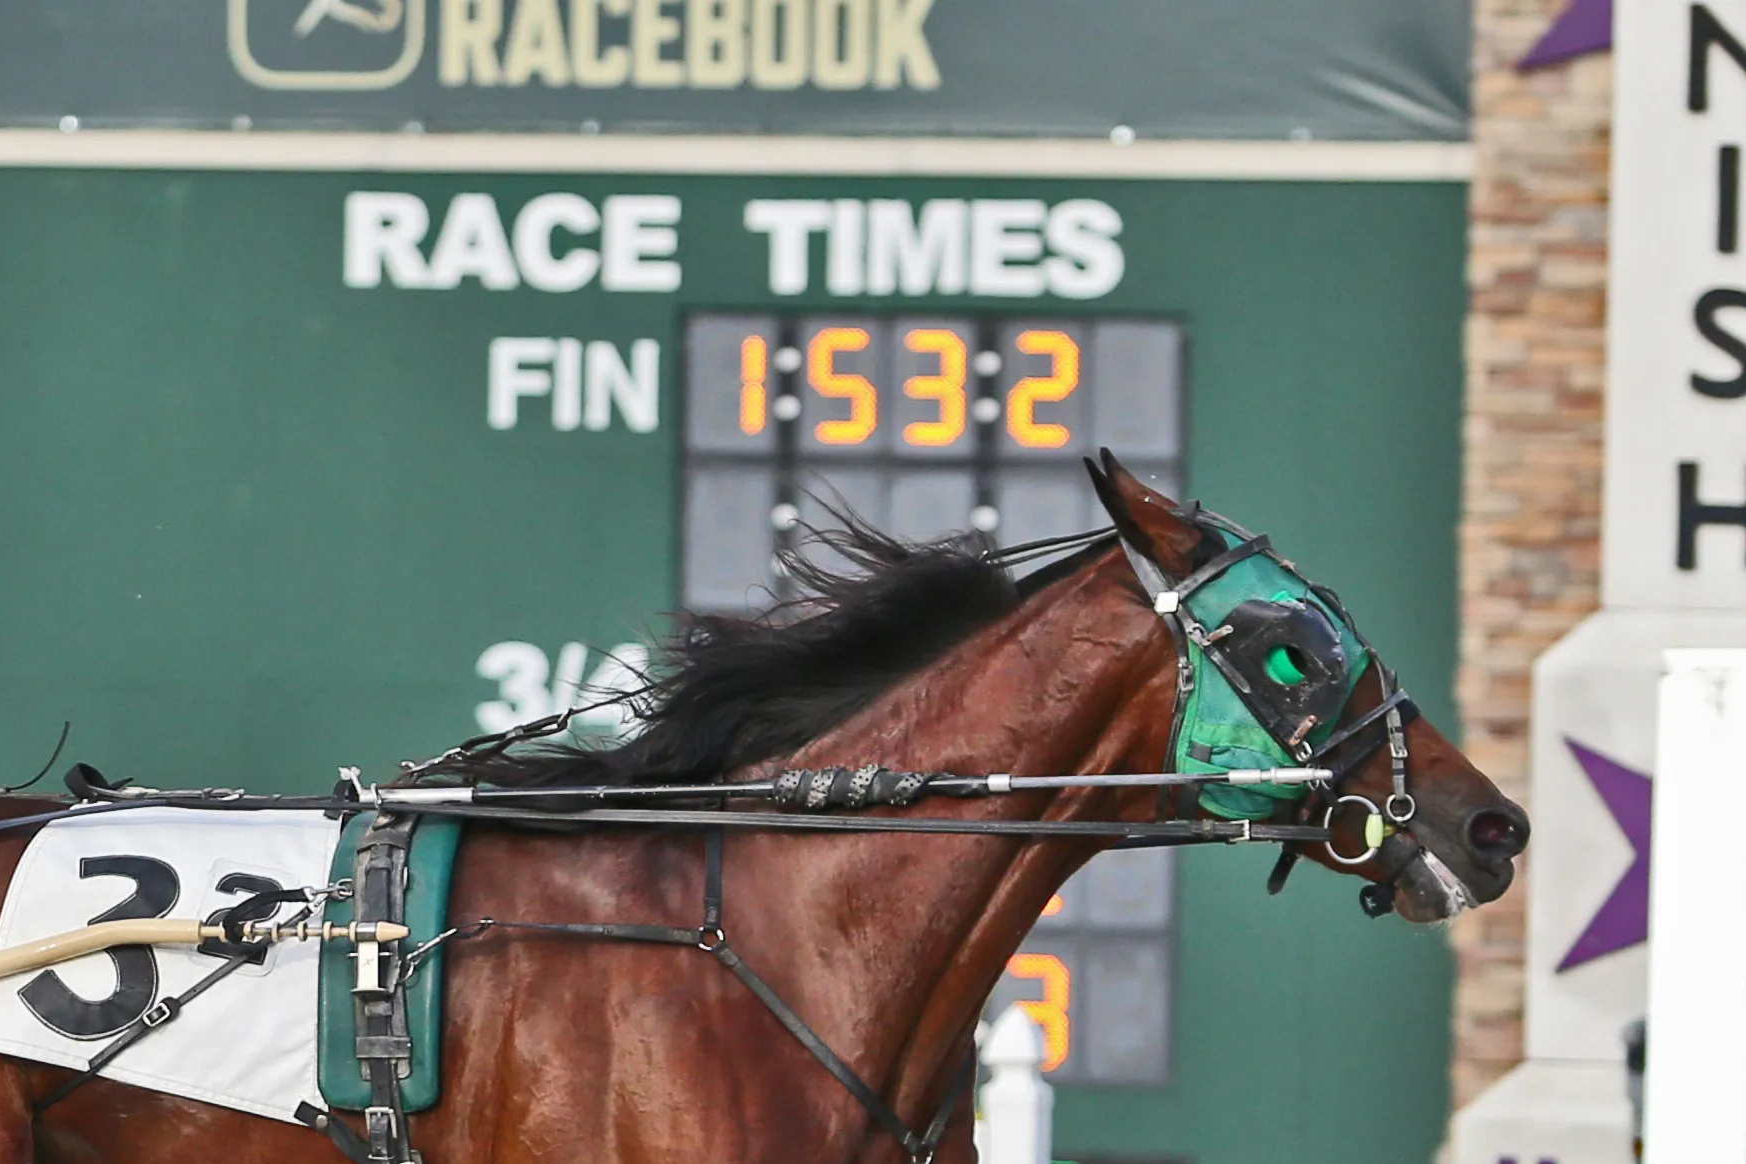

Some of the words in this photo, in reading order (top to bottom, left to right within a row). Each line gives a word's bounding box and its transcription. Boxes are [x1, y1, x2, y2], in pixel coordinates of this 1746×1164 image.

[437, 0, 942, 91] RACEBOOK
[343, 191, 681, 292] RACE
[743, 198, 1125, 298] TIMES
[487, 336, 660, 432] FIN
[17, 855, 180, 1041] 3
